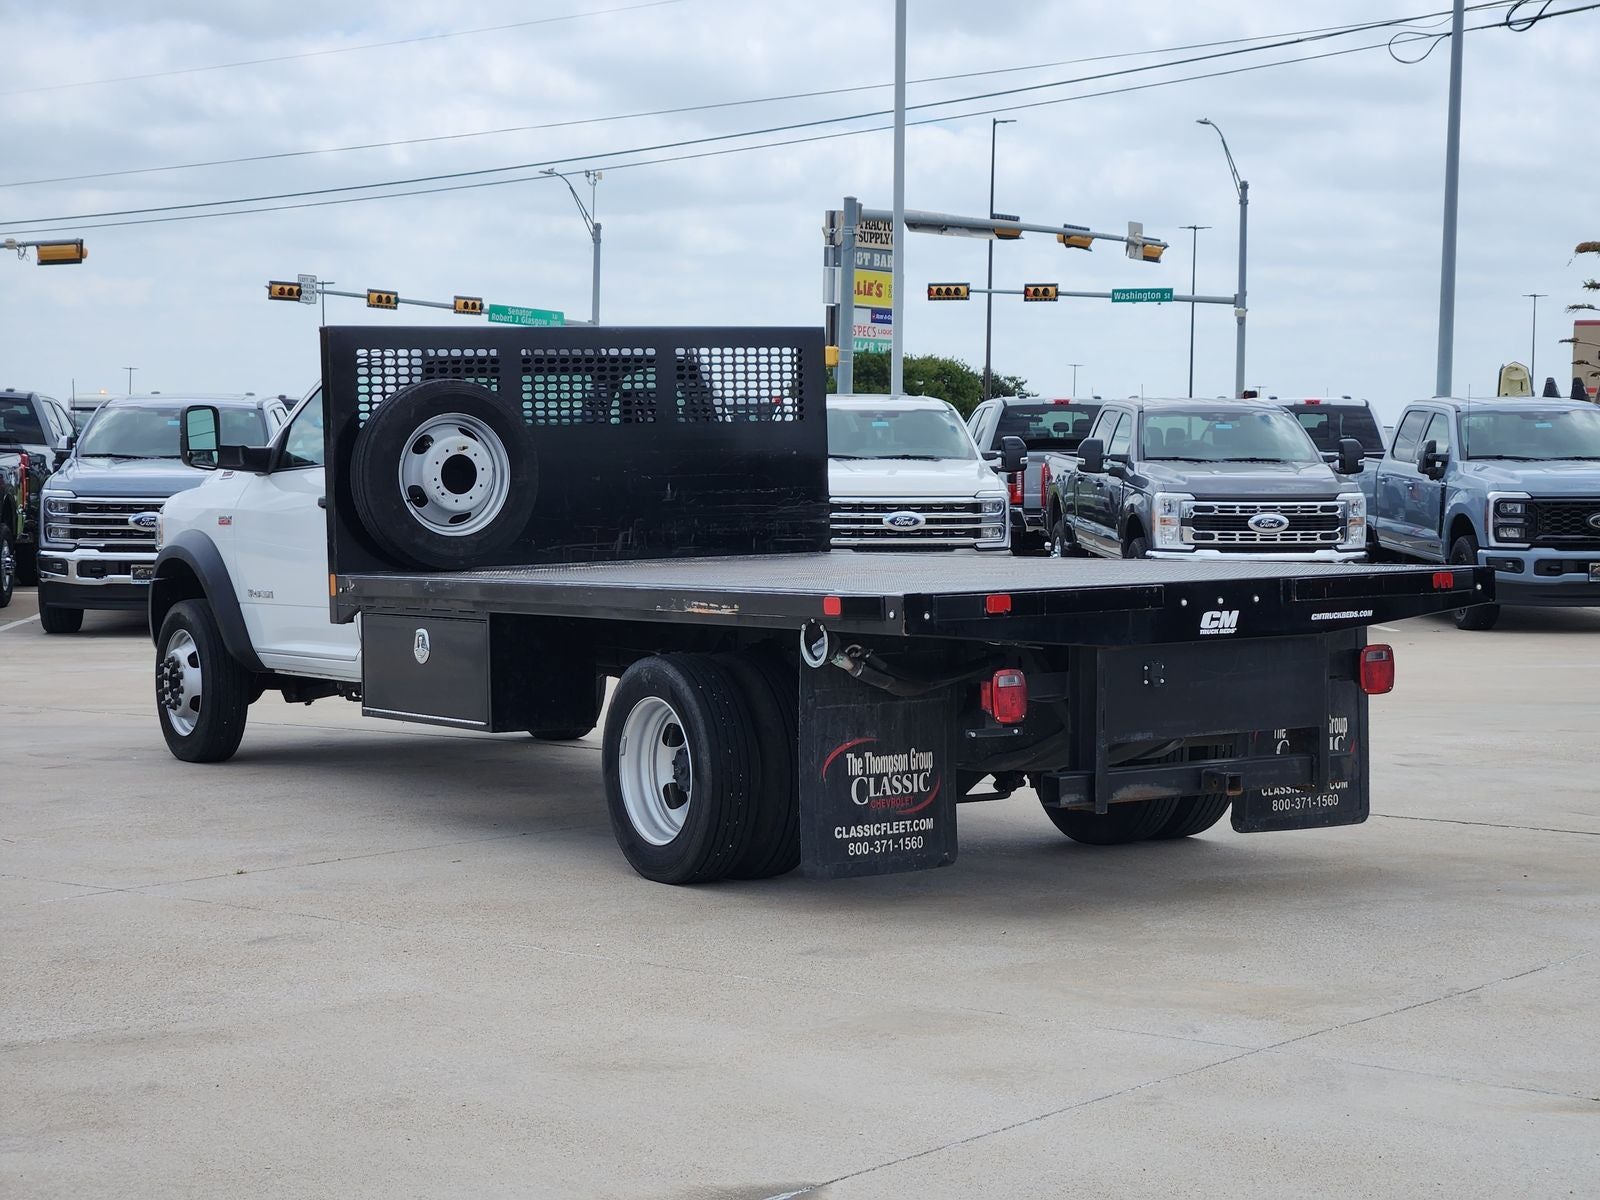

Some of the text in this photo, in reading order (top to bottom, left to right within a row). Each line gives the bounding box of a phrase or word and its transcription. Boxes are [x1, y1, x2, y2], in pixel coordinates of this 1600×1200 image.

[860, 220, 893, 232] RACTO
[858, 230, 890, 245] SUPPLY
[855, 251, 892, 268] OT BAR
[854, 280, 883, 298] LIE'S
[1114, 291, 1161, 301] Washington
[508, 307, 532, 316] Senator
[491, 313, 513, 322] Robert
[521, 316, 548, 326] Glasgow
[854, 341, 874, 352] LLAR
[894, 517, 915, 526] Ford
[1259, 519, 1279, 528] Ford
[1200, 610, 1240, 628] CM
[1311, 610, 1373, 620] CMTRUCKBEDS.COM
[846, 747, 933, 777] The Thompson Group
[851, 772, 930, 805] CLASSIC
[871, 796, 914, 809] CHEVROLET
[1272, 794, 1338, 811] 800-371-1560
[834, 818, 934, 839] CLASSICFLEET.COM
[848, 836, 924, 856] 800-371-1560
